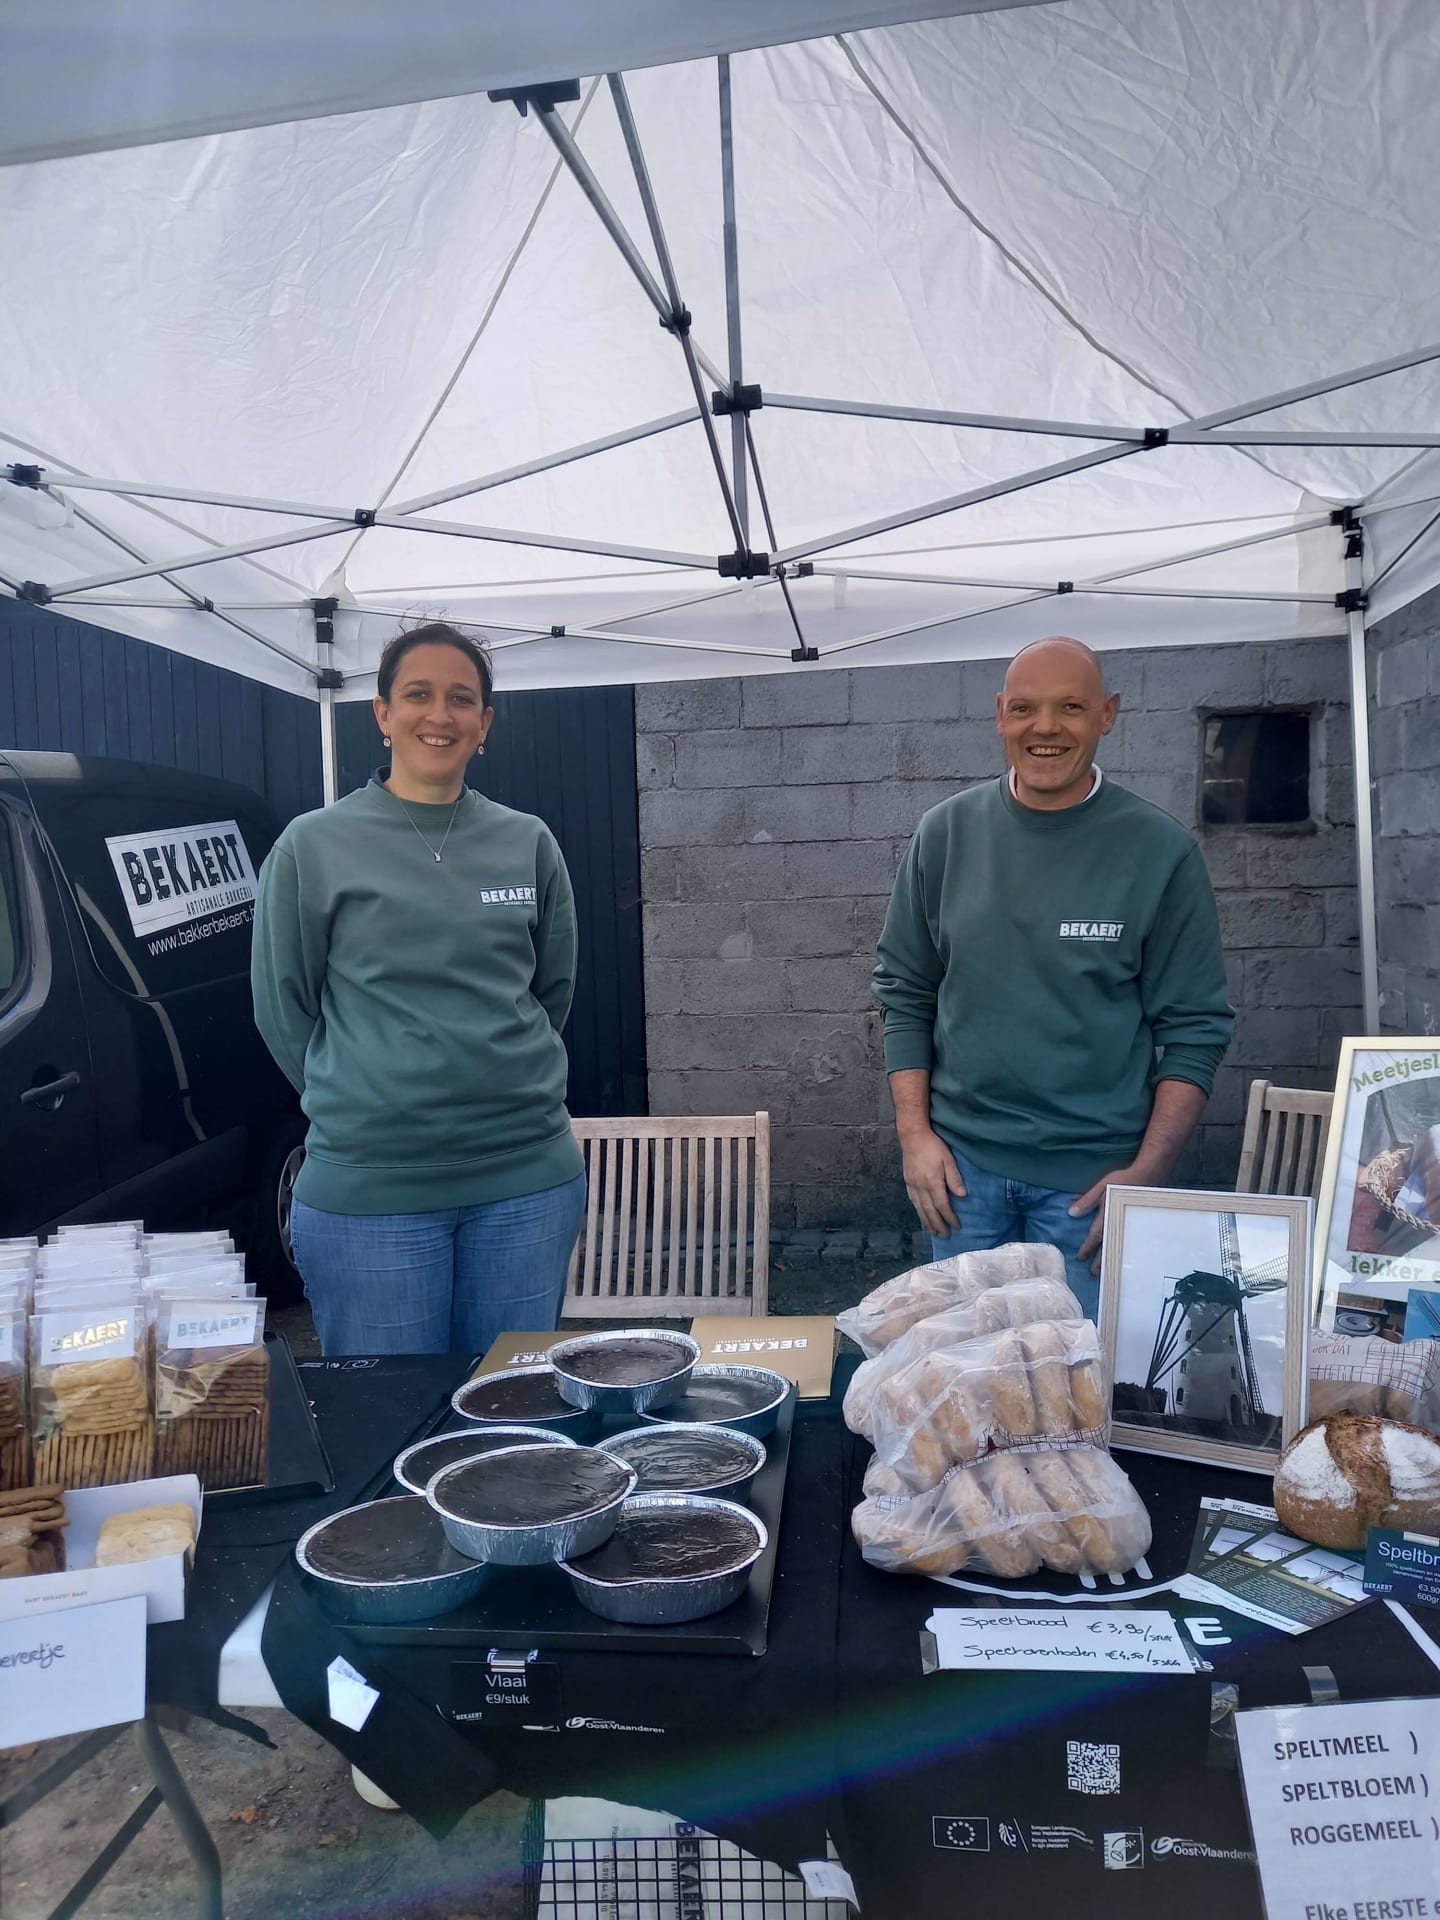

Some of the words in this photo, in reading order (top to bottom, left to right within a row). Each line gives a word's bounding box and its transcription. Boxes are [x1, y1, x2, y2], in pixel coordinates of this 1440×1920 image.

[121, 833, 247, 907] BEKAERT
[186, 893, 225, 916] ARTISANALE
[480, 886, 536, 904] BEKAERT
[1059, 922, 1124, 938] BEKAERT
[1351, 1255, 1424, 1281] lekker
[176, 1315, 250, 1338] BEKAERT
[711, 1338, 808, 1354] BEKAERT
[1378, 1541, 1440, 1567] Speltbr
[484, 1673, 528, 1688] Vlaai
[485, 1693, 531, 1705] €9/stuk
[1274, 1734, 1390, 1761] SPELTMEEL
[1281, 1775, 1416, 1803] SPELTBLOEM
[1289, 1819, 1422, 1846] ROGGEMEEL
[1173, 1845, 1258, 1861] Oost-Vlaander
[1305, 1903, 1348, 1920] Elke
[1353, 1898, 1428, 1920] EERSTE
